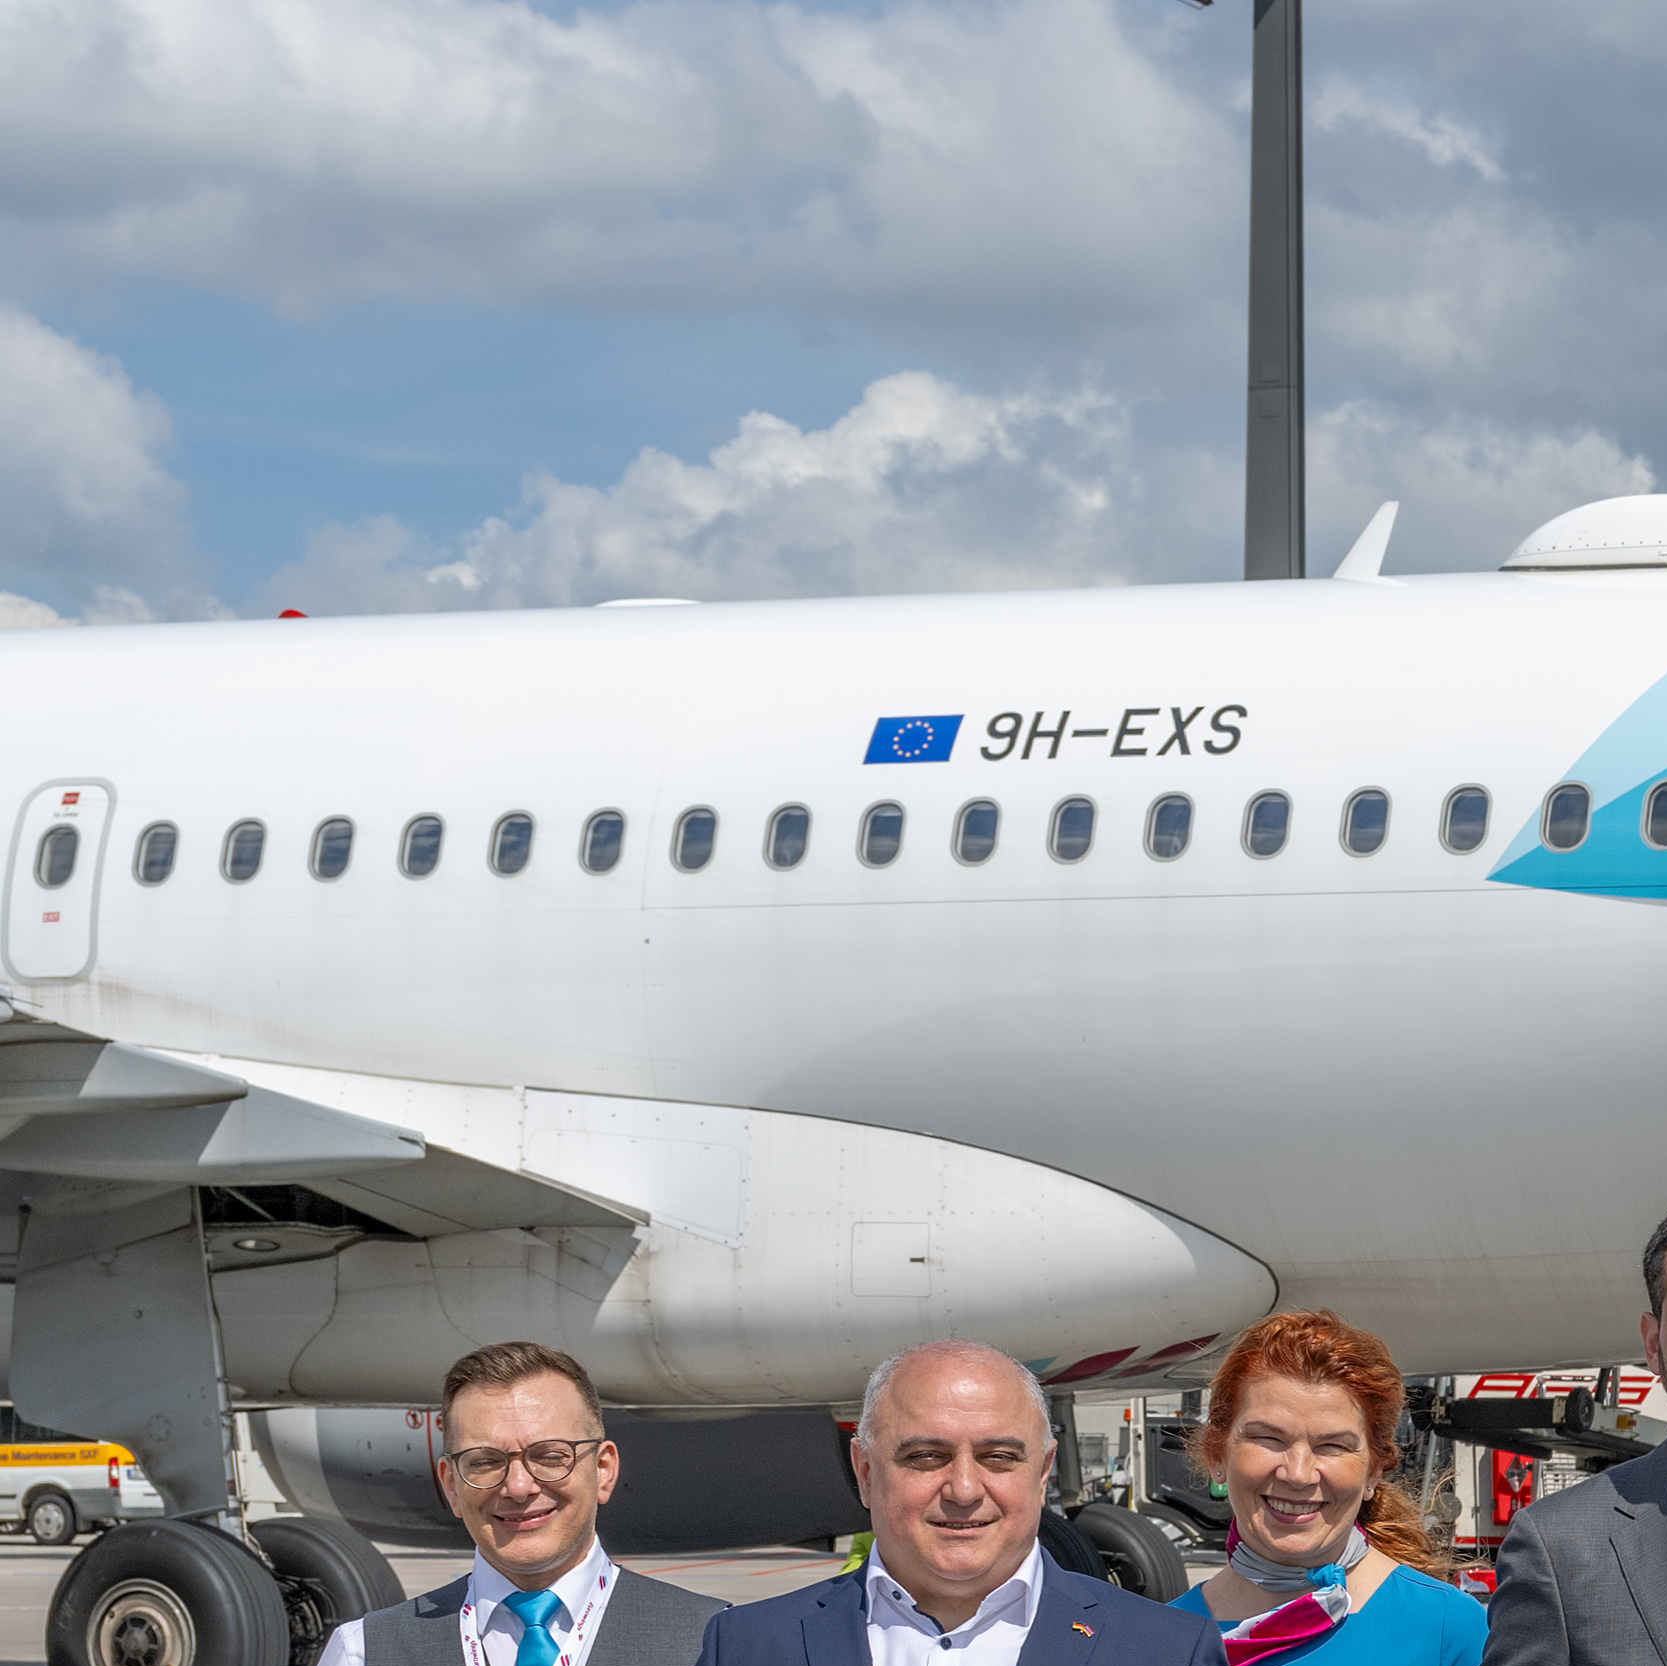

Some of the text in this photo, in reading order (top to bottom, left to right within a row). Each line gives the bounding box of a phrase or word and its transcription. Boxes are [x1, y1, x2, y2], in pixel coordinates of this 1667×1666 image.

[980, 704, 1248, 761] 9H-EXS
[12, 1451, 76, 1461] Maintenance
[80, 1449, 99, 1459] SXF
